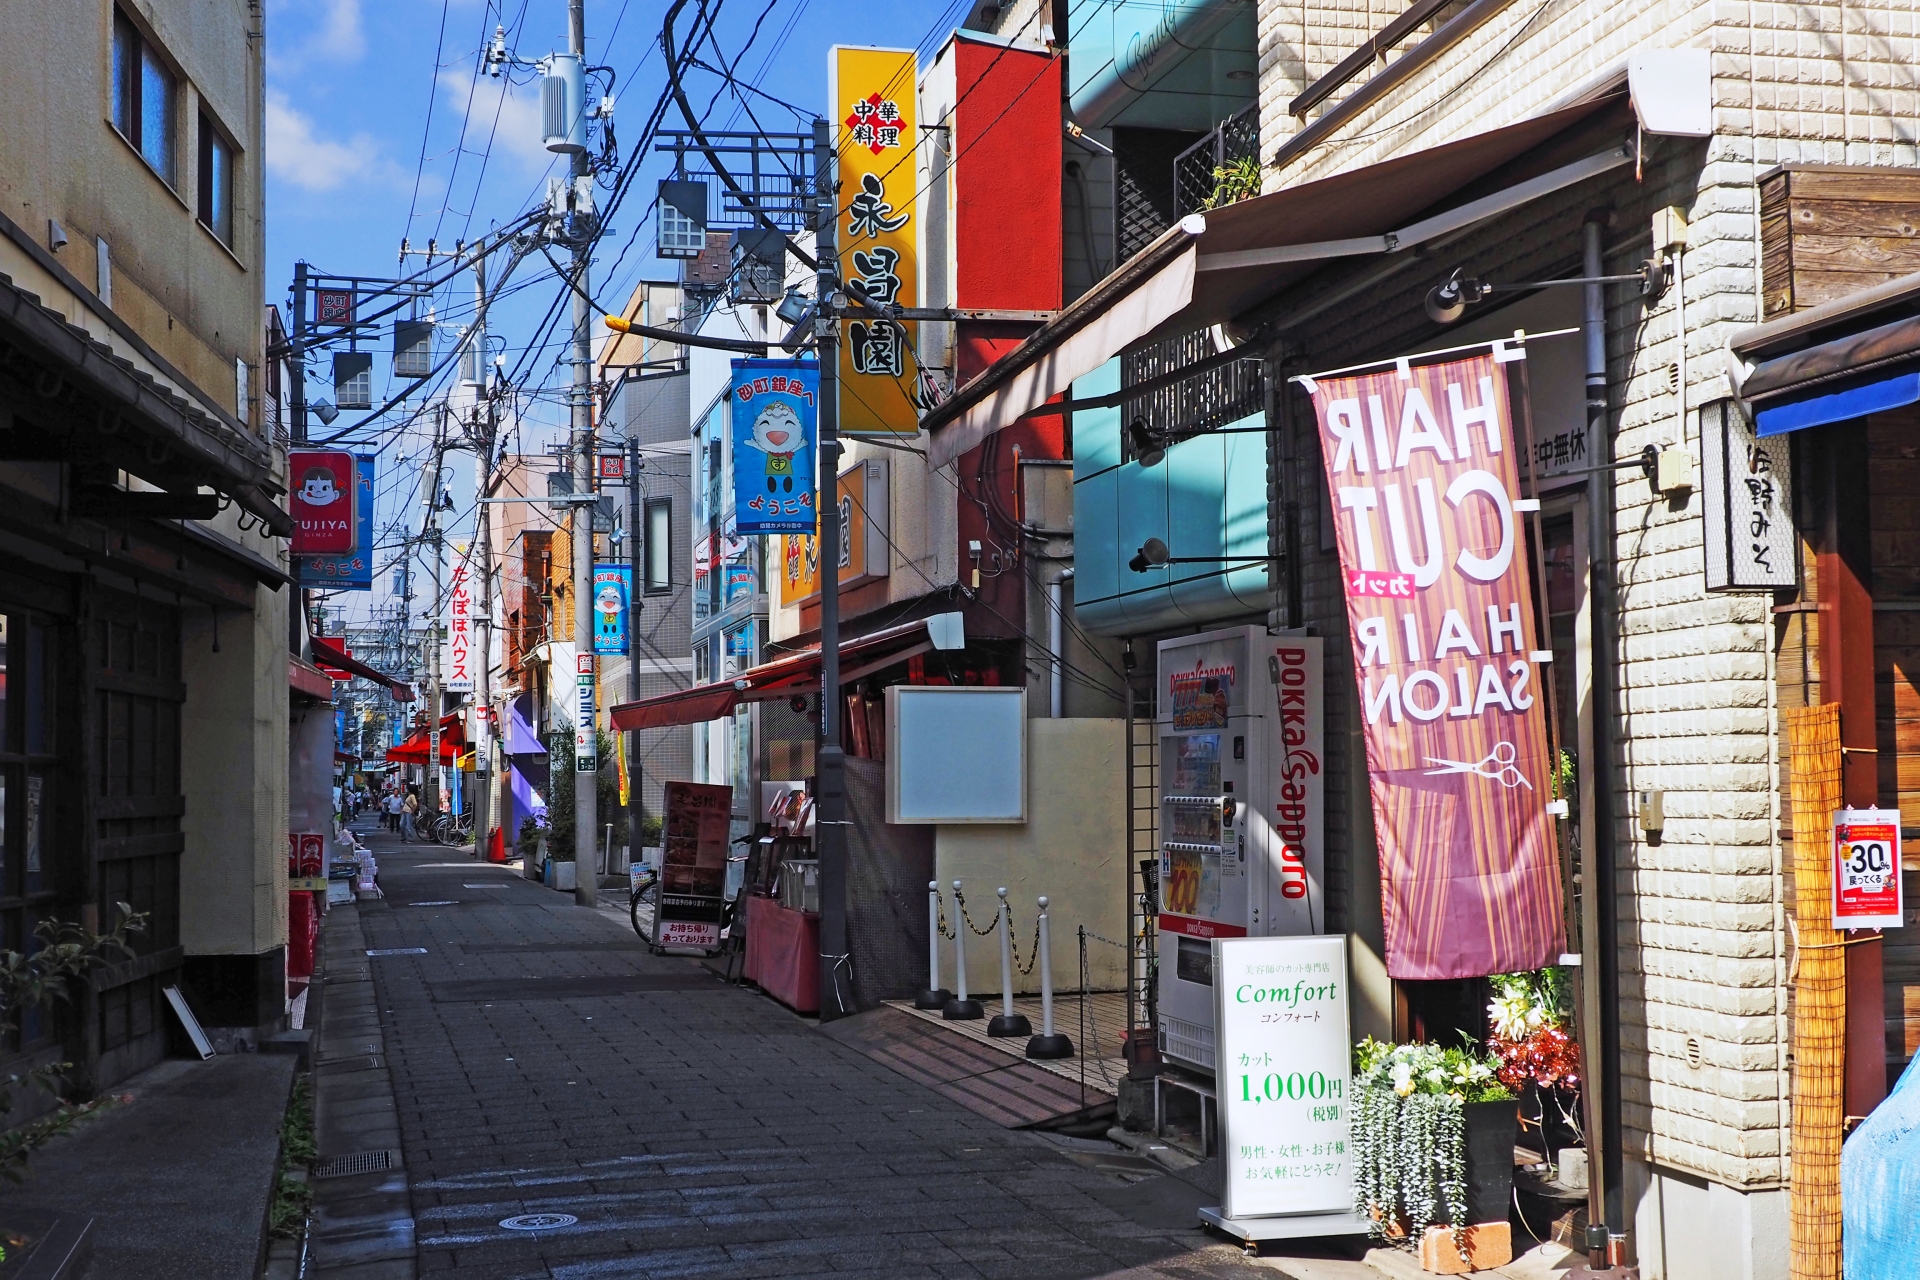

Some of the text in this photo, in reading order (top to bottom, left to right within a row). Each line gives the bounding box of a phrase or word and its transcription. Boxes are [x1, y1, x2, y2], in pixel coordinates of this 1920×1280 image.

[853, 99, 899, 123] 中華
[853, 125, 900, 147] 料理
[848, 172, 909, 376] 永昌園
[323, 295, 346, 307] 砂町
[736, 375, 814, 407] 砂町銀座へ
[749, 492, 812, 516] ようこそ
[296, 520, 348, 530] UJIYA
[311, 558, 364, 576] ようこそ
[451, 567, 471, 680] たんぽぽハウス
[579, 688, 593, 728] シミズ
[1849, 875, 1882, 886] 戻ってくる
[669, 923, 709, 933] お持ち帰り
[662, 933, 715, 944] 承っております
[1246, 962, 1330, 975] 美容師のカット専門店
[1236, 980, 1337, 1009] Comfort
[1261, 1010, 1321, 1023] コンフォート
[1238, 1052, 1272, 1067] カット
[1239, 1071, 1342, 1106] 1,000円
[1306, 1104, 1343, 1123] (税別)
[1240, 1140, 1346, 1160] 男性・女性・お子様
[1245, 1163, 1342, 1180] お気軽にどうぞ!
